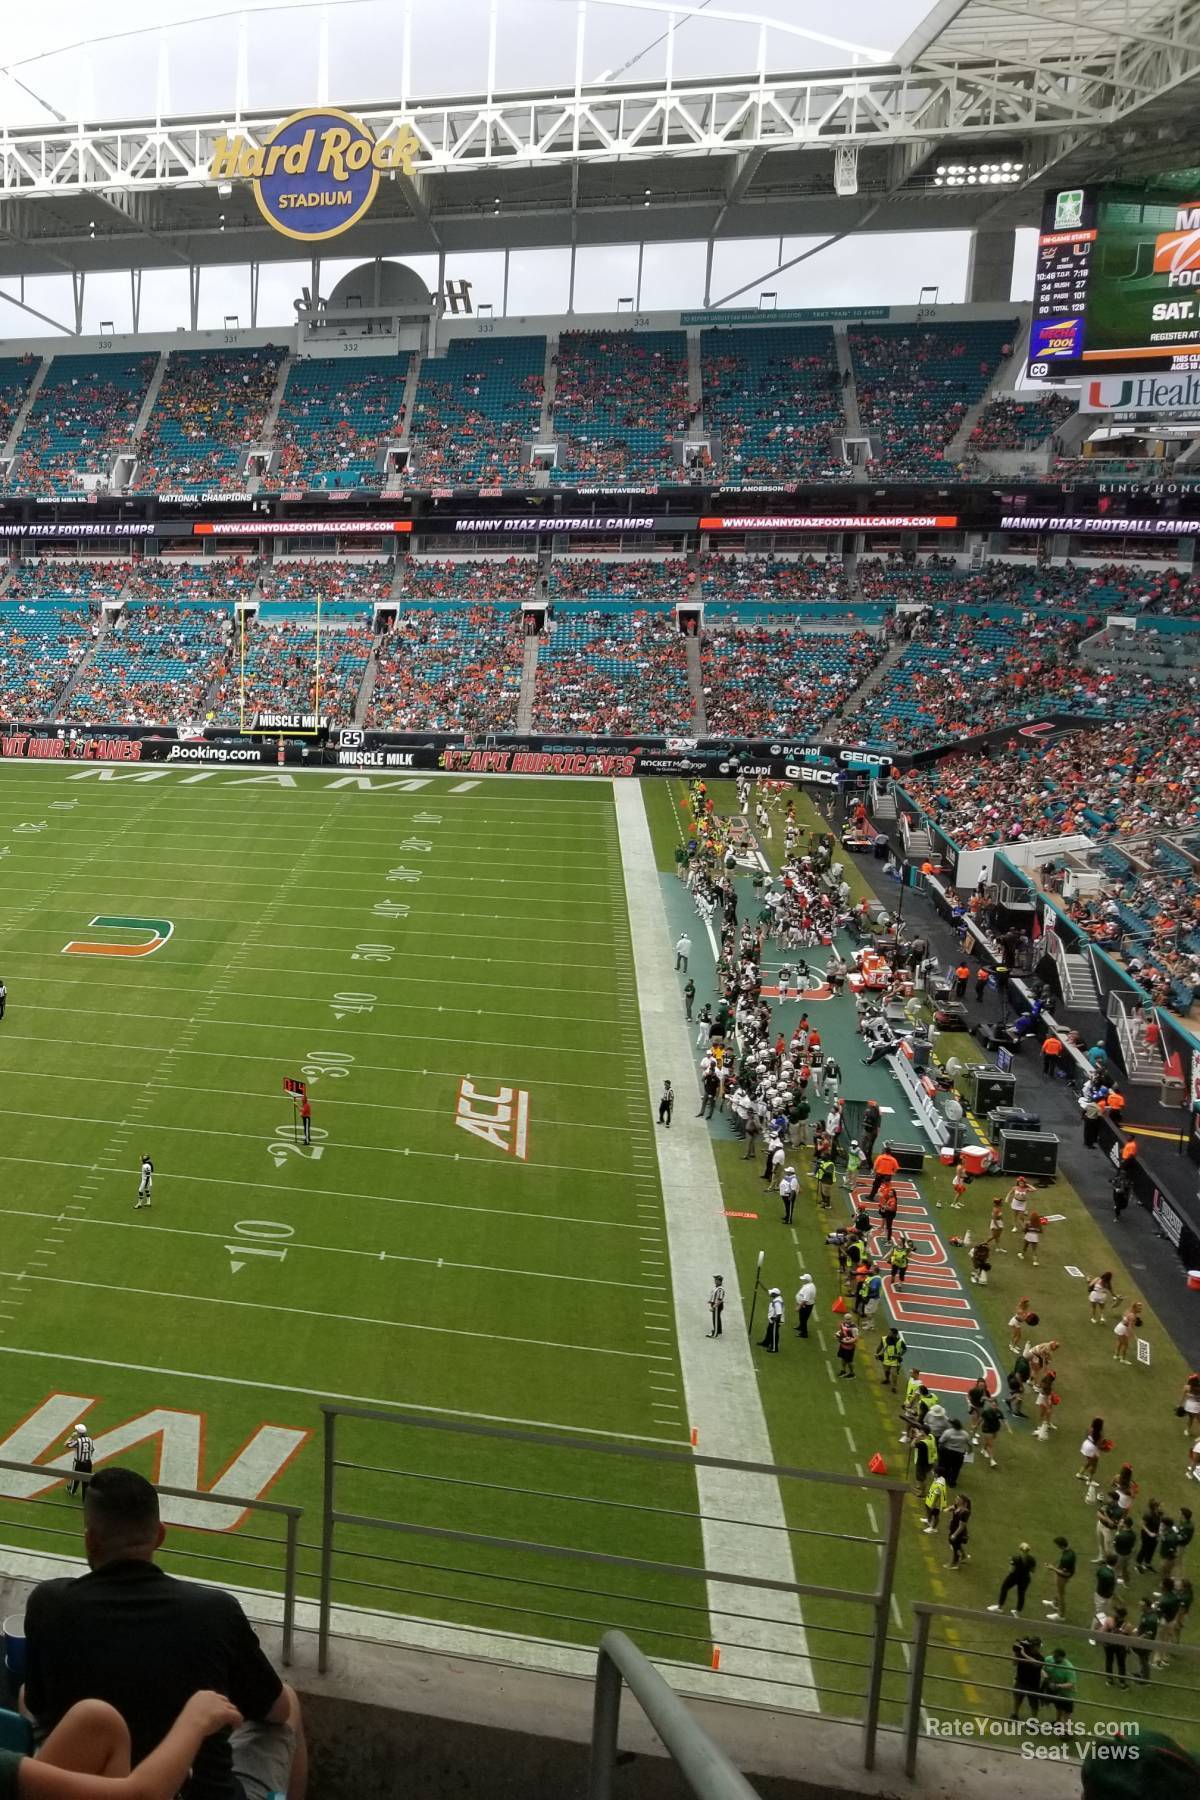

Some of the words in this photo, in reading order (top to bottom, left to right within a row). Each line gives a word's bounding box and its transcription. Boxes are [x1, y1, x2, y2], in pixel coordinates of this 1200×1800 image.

[210, 129, 315, 179] Hard
[317, 123, 420, 181] Rock
[279, 191, 352, 208] STADIUM
[1043, 235, 1070, 243] IN-GAME
[1072, 233, 1091, 241] STATS
[918, 308, 935, 317] 336
[1152, 301, 1194, 321] SAT.
[478, 324, 494, 332] 333
[634, 317, 649, 327] 334
[223, 335, 237, 344] 331
[1150, 331, 1188, 341] REGISTER
[1189, 331, 1198, 339] AT
[98, 340, 112, 349] 330
[1048, 338, 1074, 348] TOOL
[1172, 355, 1188, 363] THIS
[1032, 365, 1046, 375] CC
[1170, 363, 1189, 371] AGES
[1099, 484, 1140, 493] RING
[159, 493, 199, 502] NATIONAL
[201, 492, 252, 502] CHAMPIONS
[212, 521, 394, 533] WWW.MANNYDIAZFOOTBALLCAMPS.COM
[455, 519, 502, 531] MANNY
[503, 519, 536, 530] DIAZ
[538, 519, 602, 530] FOOTBALL
[605, 518, 654, 529] CAMPS
[722, 517, 936, 527] WWW.MANNYDIAZFOOTBALLCAMPS.COM
[1000, 517, 1046, 529] MANNY
[1049, 518, 1081, 530] DIAZ
[1083, 519, 1152, 532] FOOTBALL
[29, 524, 56, 536] DIAZ
[58, 525, 112, 535] FOOTBALL
[115, 524, 155, 535] CAMPS
[259, 714, 301, 728] MUSCLE
[302, 715, 328, 728] MILK
[343, 731, 361, 745] 25
[171, 745, 260, 761] Booking.com
[783, 745, 821, 757] BACARDÍ
[840, 750, 893, 765] GEICO
[340, 751, 382, 765] MUSCLE
[384, 752, 414, 766] MILK
[66, 769, 482, 792] MIAMI
[411, 814, 443, 824] 10
[400, 839, 433, 852] 20
[386, 869, 423, 883] 30
[371, 903, 410, 919] 40
[351, 944, 396, 962] 50
[329, 992, 378, 1013] 40
[301, 1051, 355, 1078] 30
[455, 1078, 513, 1152] ACC
[267, 1125, 329, 1160] 20
[225, 1220, 295, 1261] 10
[82, 1442, 89, 1453] R
